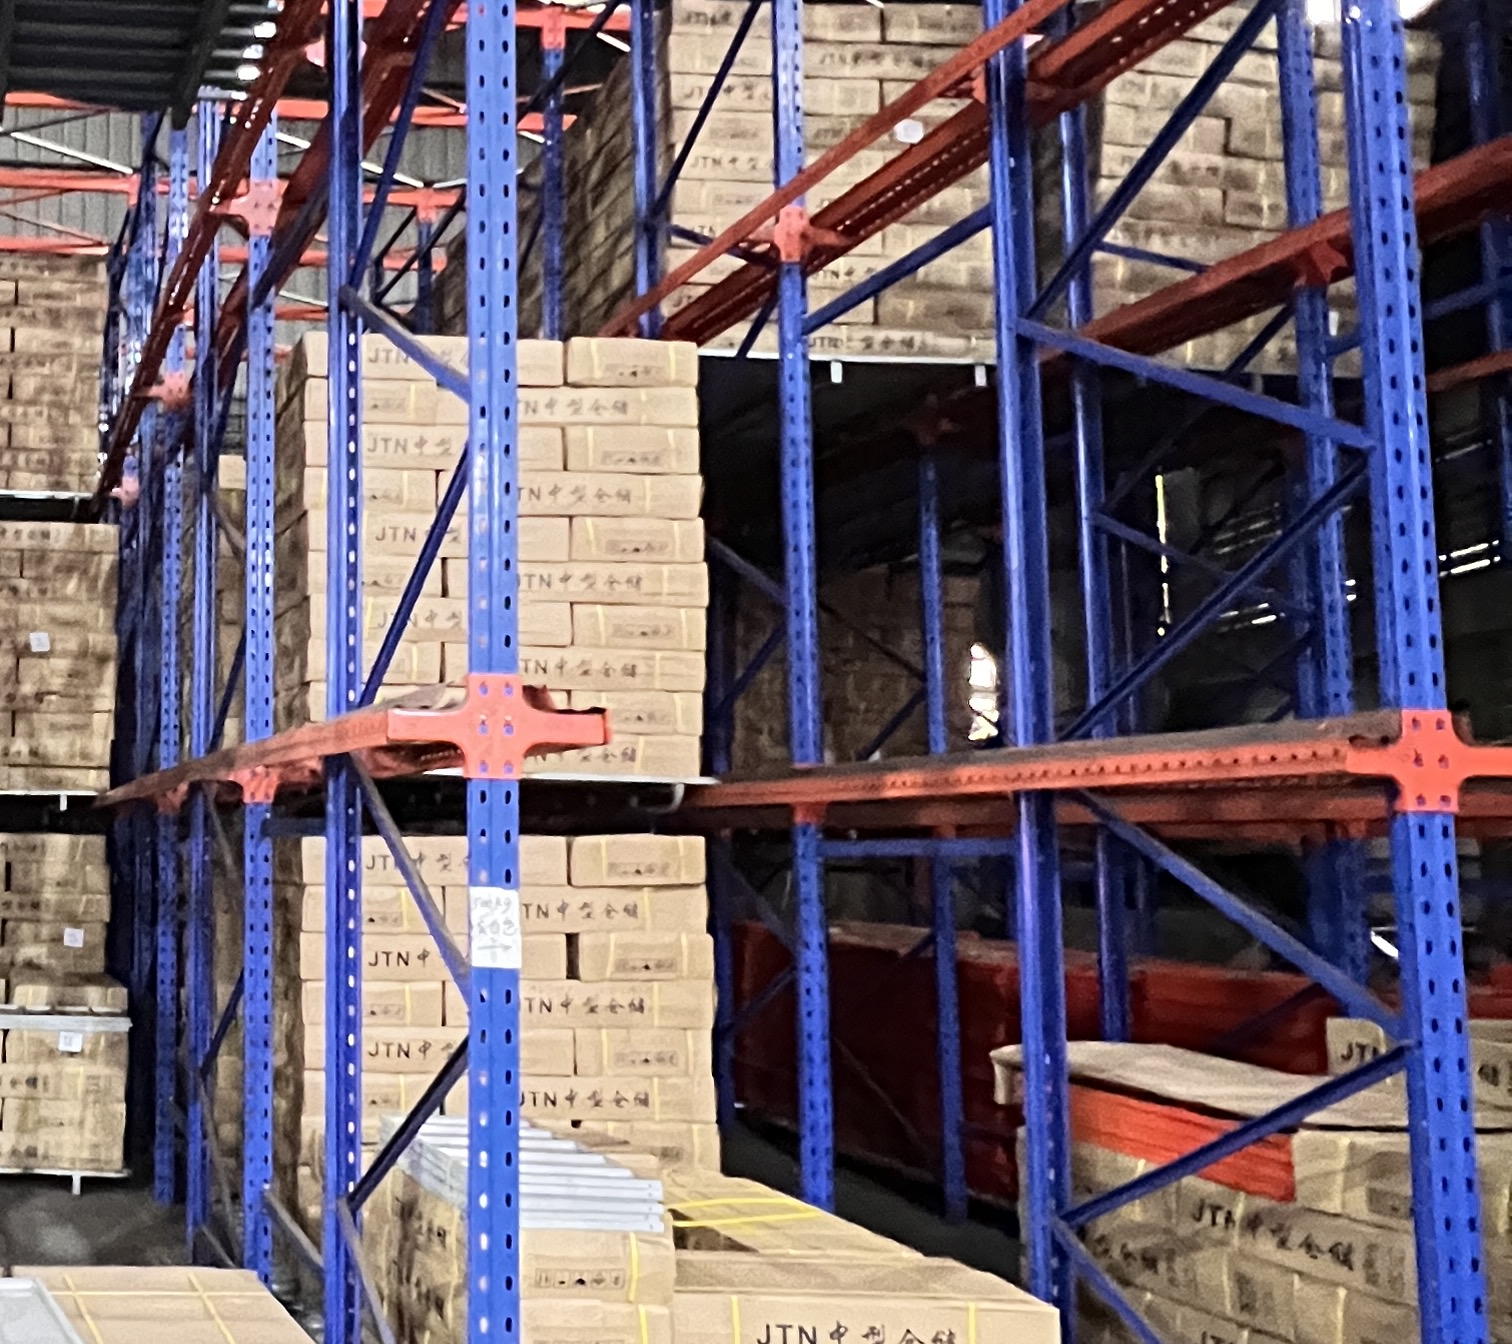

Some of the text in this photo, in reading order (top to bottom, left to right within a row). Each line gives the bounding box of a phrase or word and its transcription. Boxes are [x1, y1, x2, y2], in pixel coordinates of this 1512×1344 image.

[367, 437, 408, 454] JTN
[375, 526, 416, 543] JTN
[368, 951, 410, 968] JTN
[368, 1041, 410, 1059] JTN
